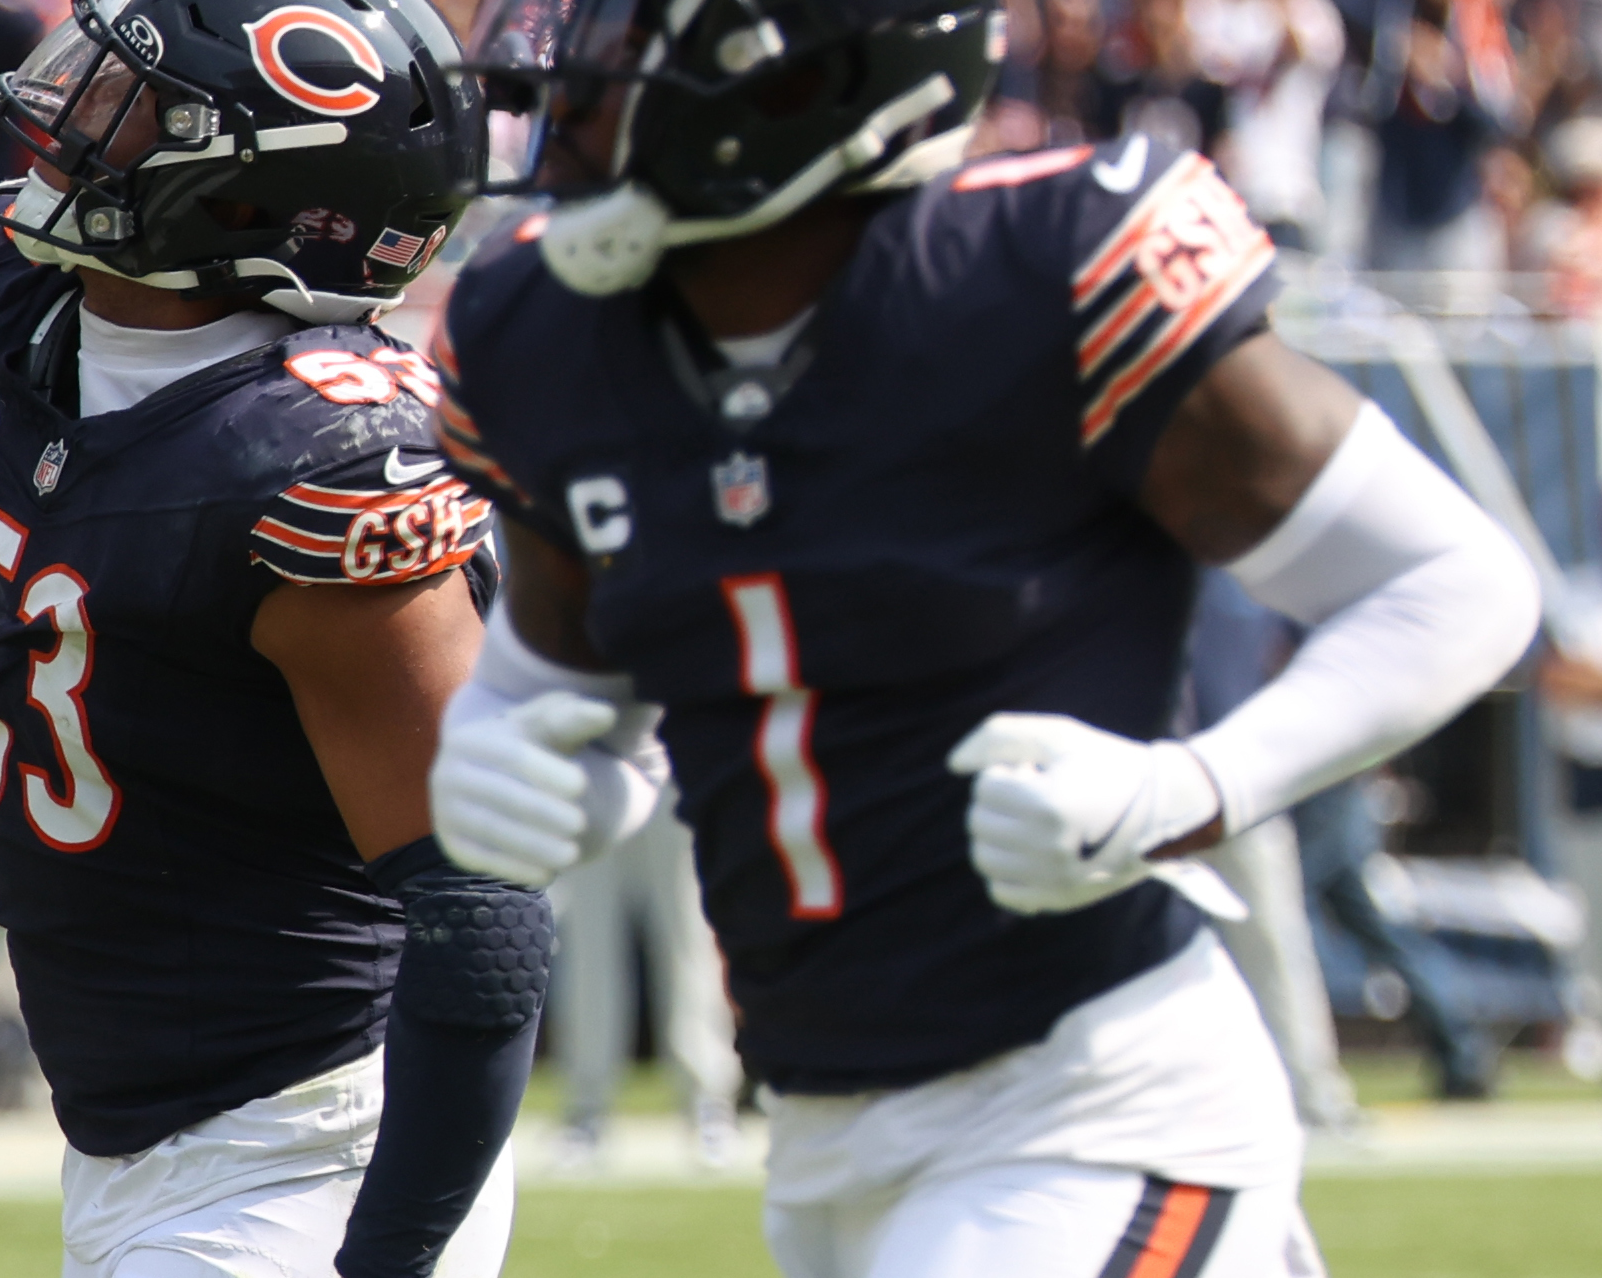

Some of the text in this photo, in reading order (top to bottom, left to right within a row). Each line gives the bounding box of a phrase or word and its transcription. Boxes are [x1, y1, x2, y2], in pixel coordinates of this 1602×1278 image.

[242, 5, 385, 116] C
[341, 494, 464, 582] GSH
[565, 475, 633, 555] C
[720, 572, 844, 919] 1
